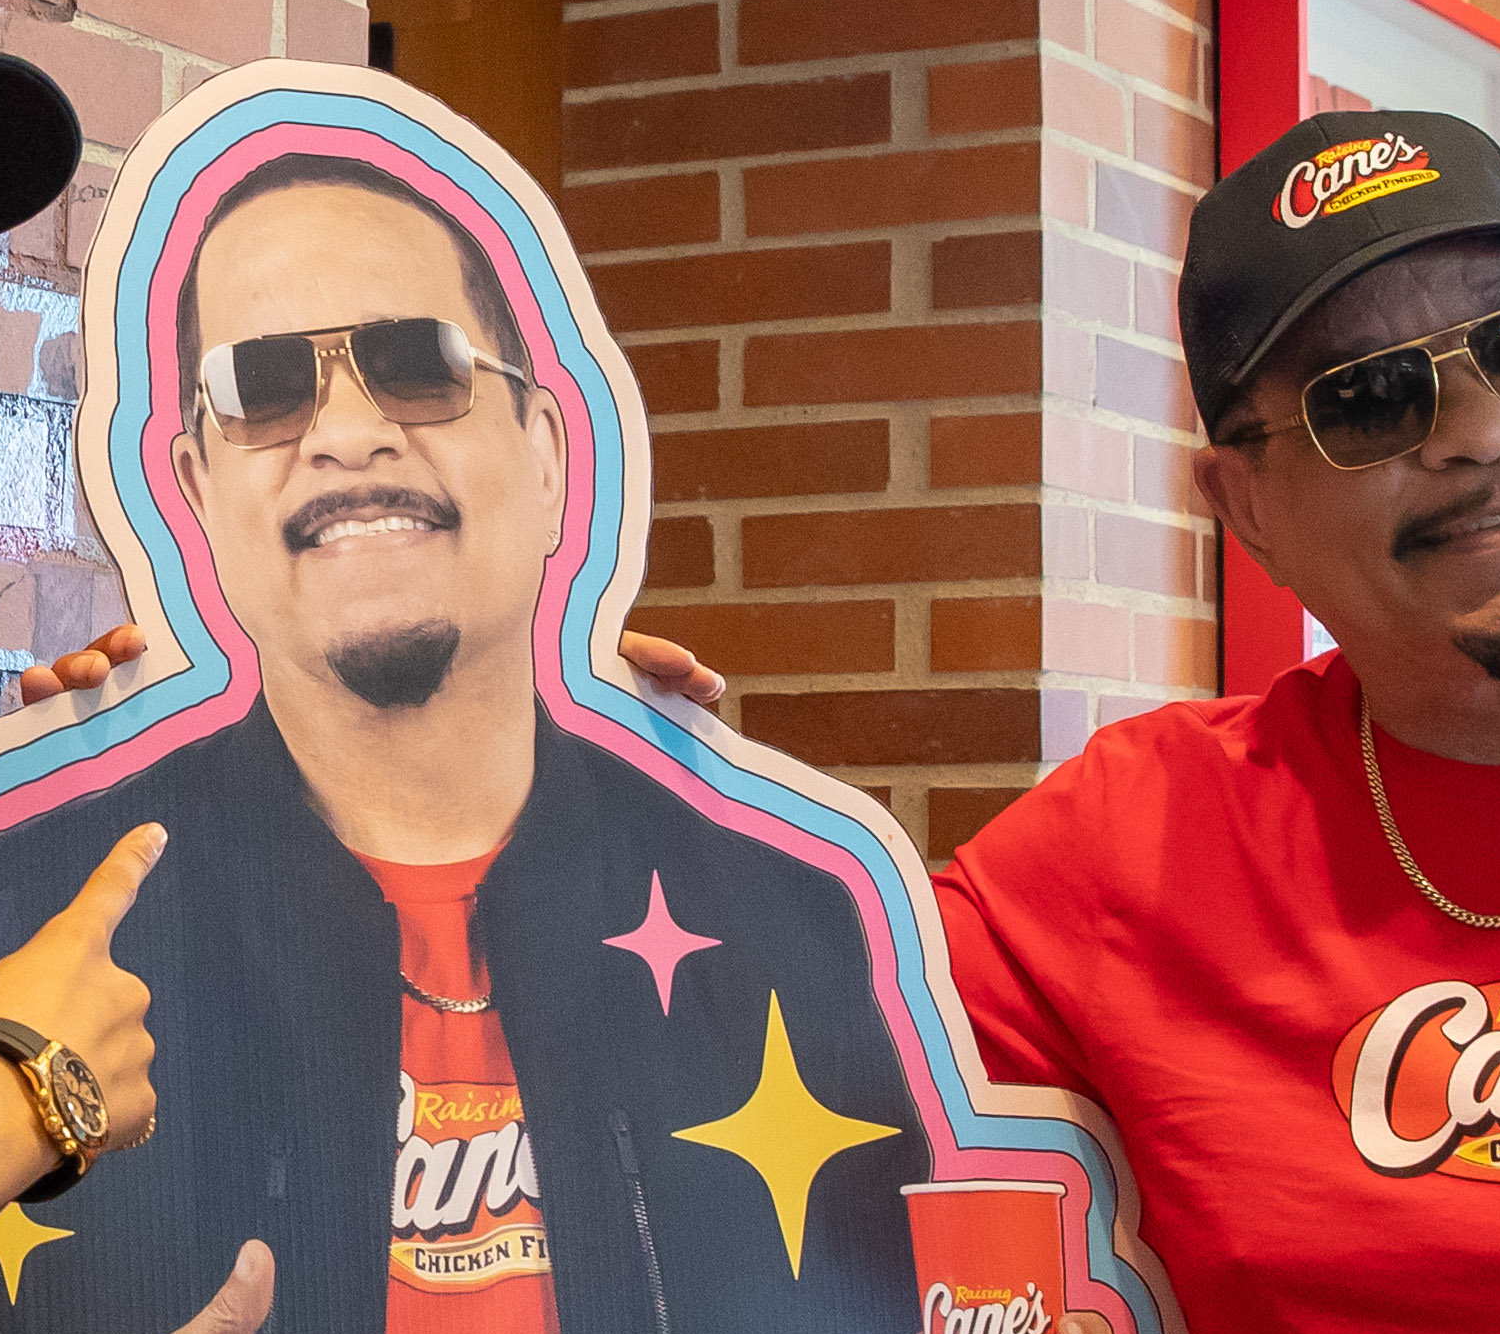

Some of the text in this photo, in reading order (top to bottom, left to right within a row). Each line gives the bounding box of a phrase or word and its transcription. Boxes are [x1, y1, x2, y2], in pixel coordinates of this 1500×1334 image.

[1314, 139, 1373, 168] Raising
[1280, 131, 1424, 229] Cane's
[414, 1240, 511, 1274] CHICKEN
[954, 1284, 1012, 1304] Raising
